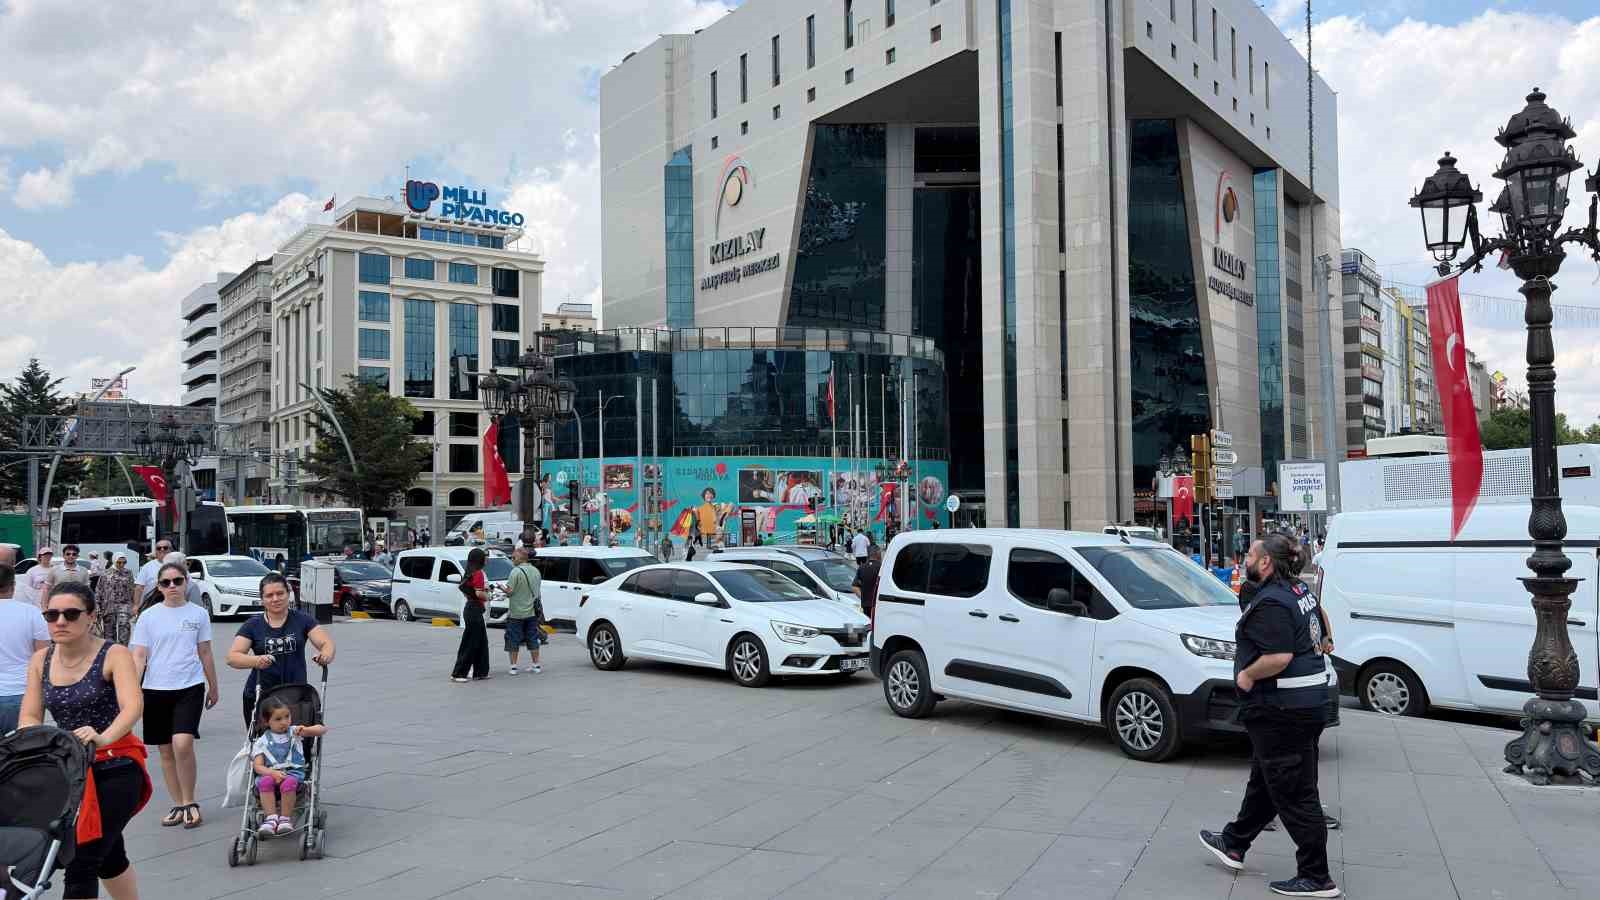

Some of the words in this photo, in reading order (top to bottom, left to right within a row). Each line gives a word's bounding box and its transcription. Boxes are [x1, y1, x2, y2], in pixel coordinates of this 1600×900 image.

[442, 202, 525, 226] PİYANGO
[709, 227, 766, 265] KIZILAY
[1214, 246, 1247, 281] KIZILAY
